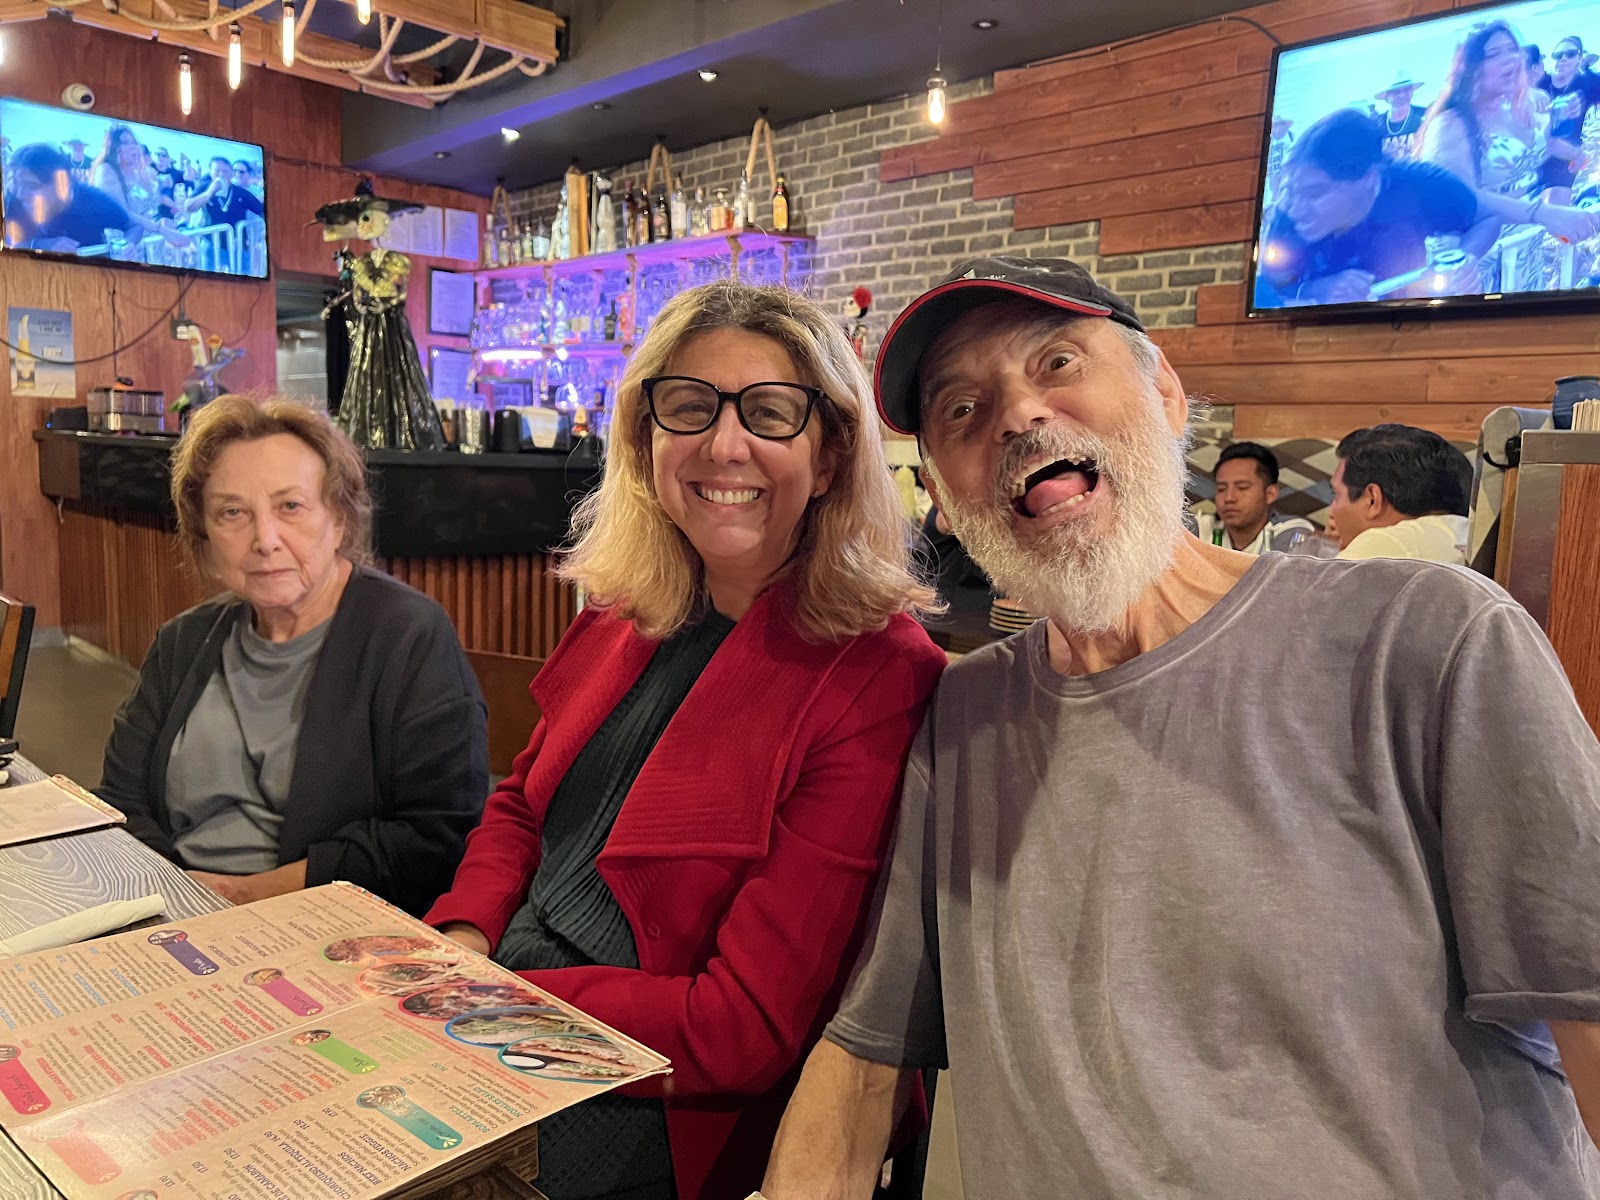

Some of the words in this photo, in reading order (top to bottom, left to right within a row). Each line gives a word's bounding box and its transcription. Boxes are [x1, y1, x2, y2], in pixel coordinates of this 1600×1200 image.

[472, 1087, 494, 1099] SALAD
[447, 1105, 474, 1121] AZTECA
[492, 1099, 522, 1116] NOPALES
[470, 1120, 490, 1132] SOPA
[359, 1134, 385, 1151] VEGGIE
[223, 1148, 239, 1158] 17.50
[277, 1141, 306, 1161] TEQUILA
[191, 1161, 208, 1172] 17.50
[337, 1152, 366, 1172] NACHOS
[380, 1150, 410, 1170] NACHOS
[243, 1164, 275, 1189] CAMARON
[307, 1166, 352, 1199] CHORIQUESO
[361, 1171, 382, 1184] BEEF
[269, 1188, 282, 1196] DE
